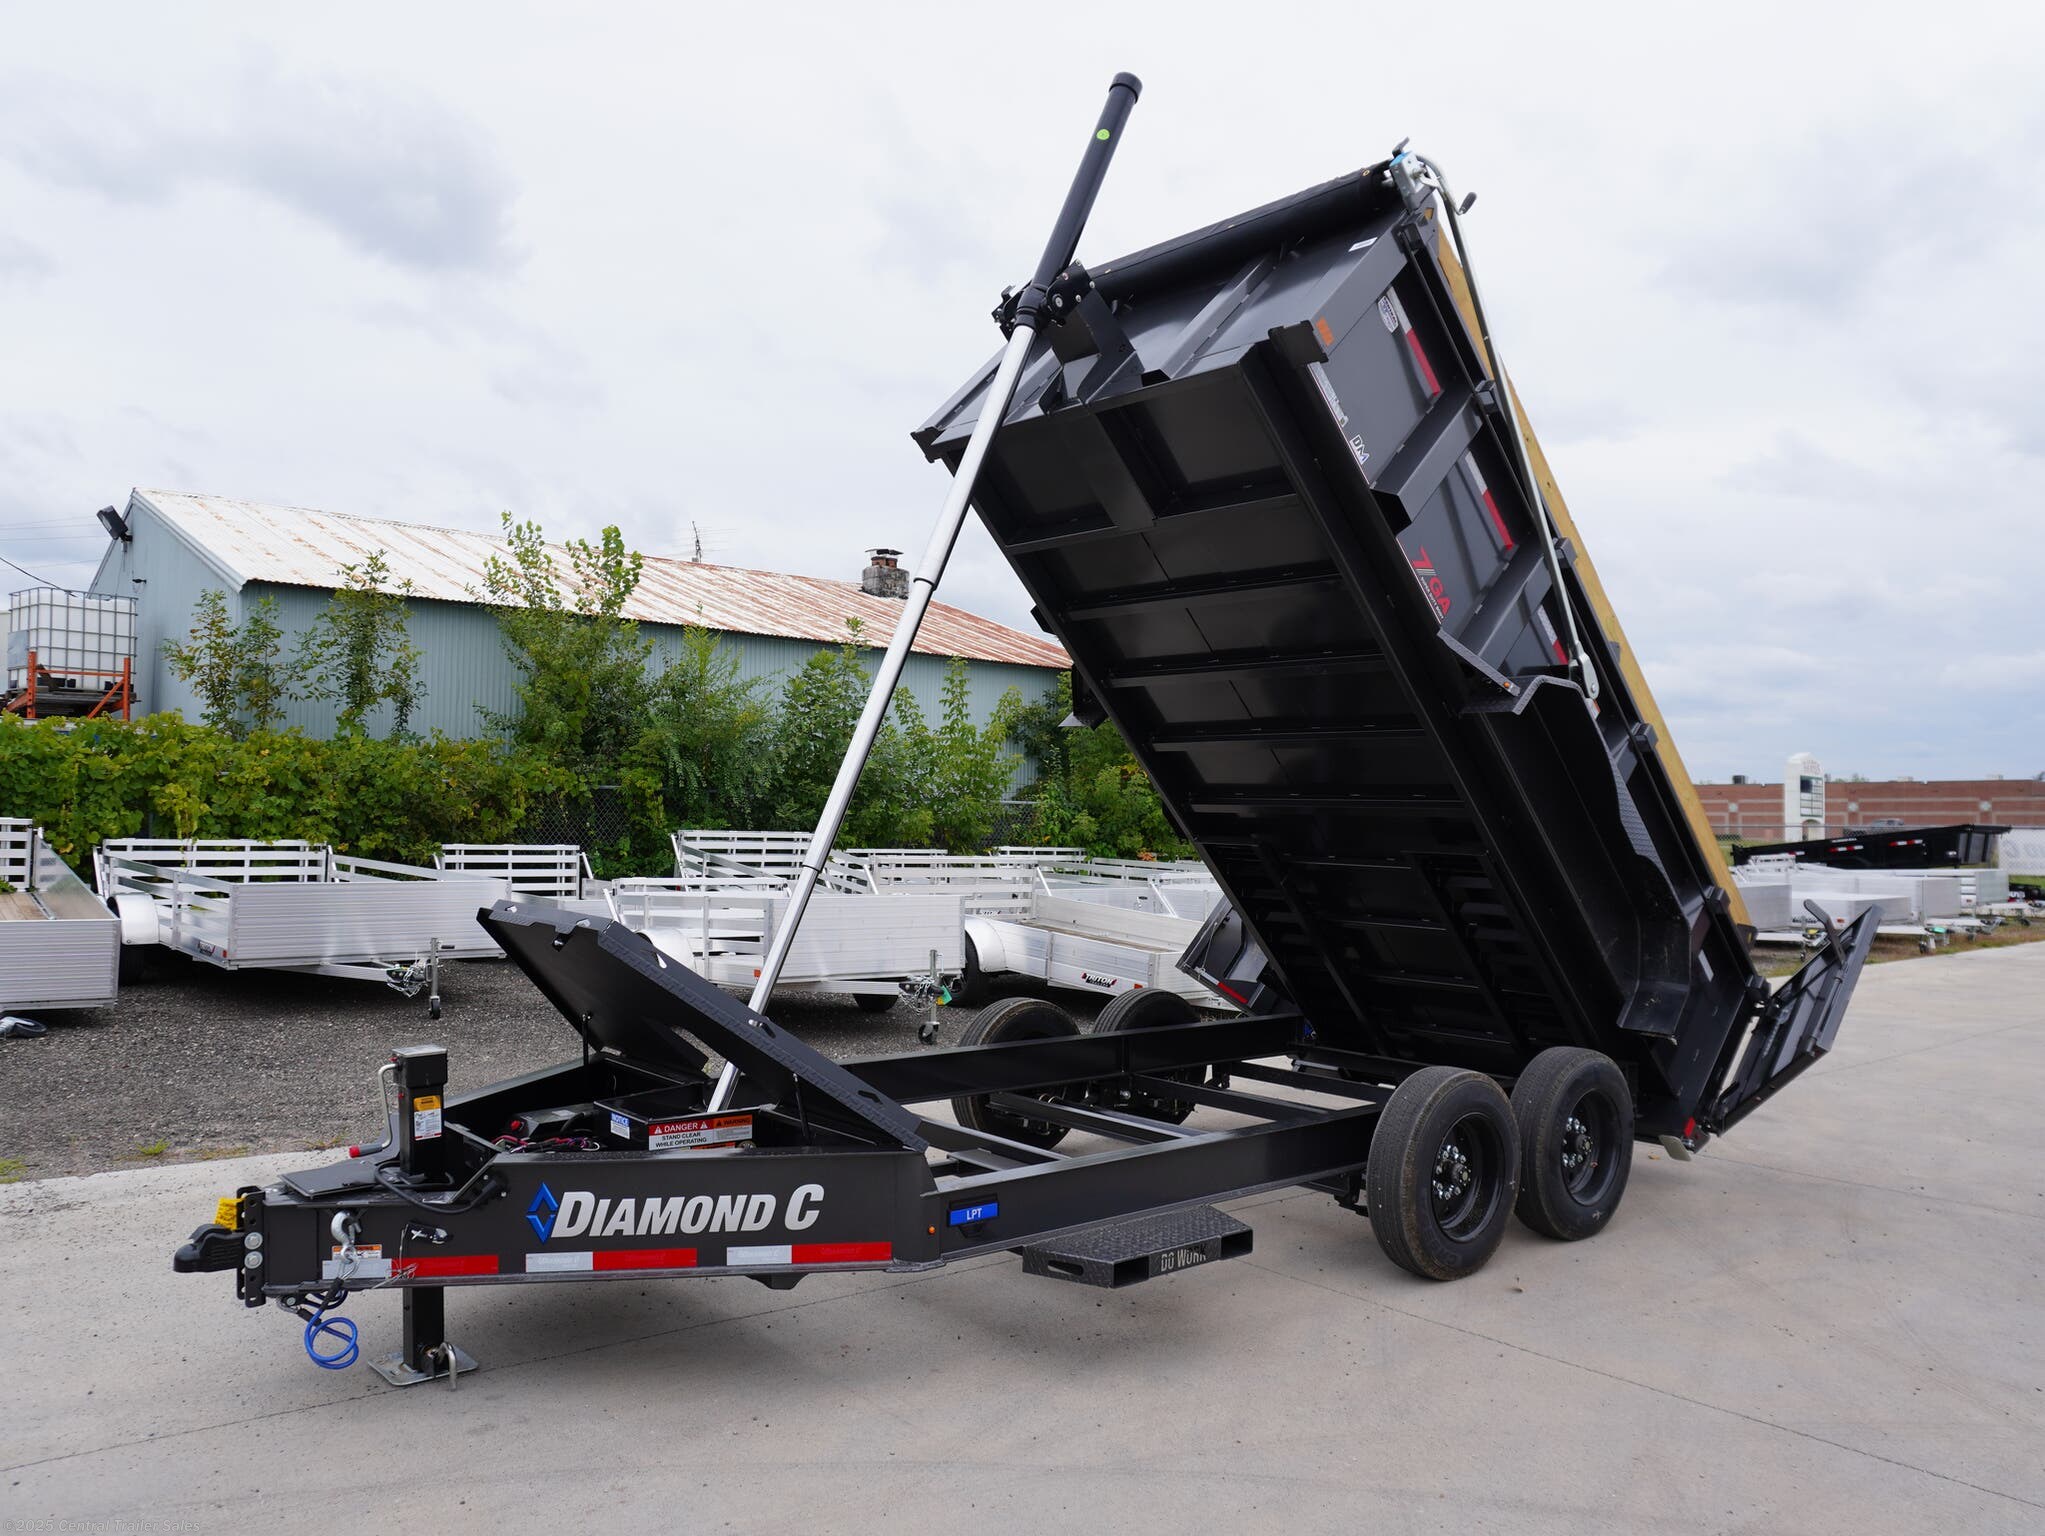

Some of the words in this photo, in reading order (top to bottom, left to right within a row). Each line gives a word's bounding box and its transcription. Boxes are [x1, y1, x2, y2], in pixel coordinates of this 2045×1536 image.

[1350, 434, 1370, 465] DM
[664, 1122, 698, 1133] DANGER
[655, 1140, 674, 1148] WHILE
[675, 1137, 707, 1146] OPERATING
[551, 1191, 777, 1238] DIAMOND
[784, 1184, 825, 1231] C
[966, 1207, 983, 1221] LPT
